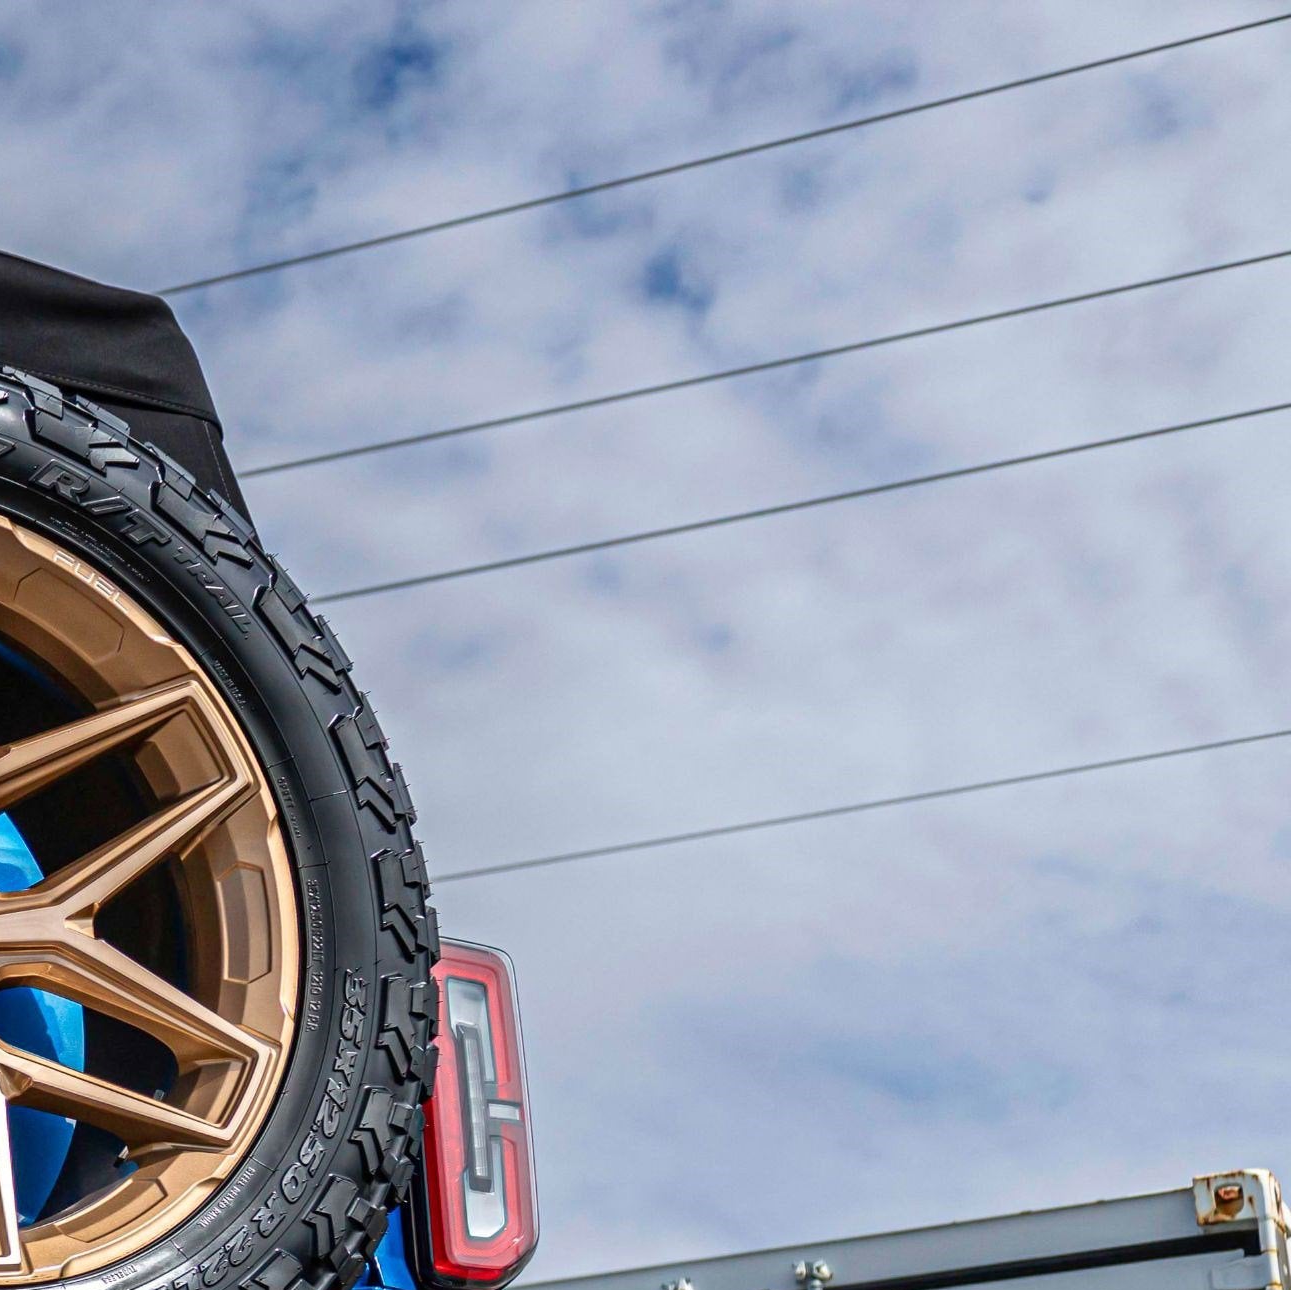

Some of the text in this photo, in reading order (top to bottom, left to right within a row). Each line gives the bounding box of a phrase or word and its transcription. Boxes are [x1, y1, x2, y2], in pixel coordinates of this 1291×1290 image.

[31, 459, 173, 546] R/T
[174, 546, 249, 636] TRAIL
[53, 550, 130, 613] FUEL
